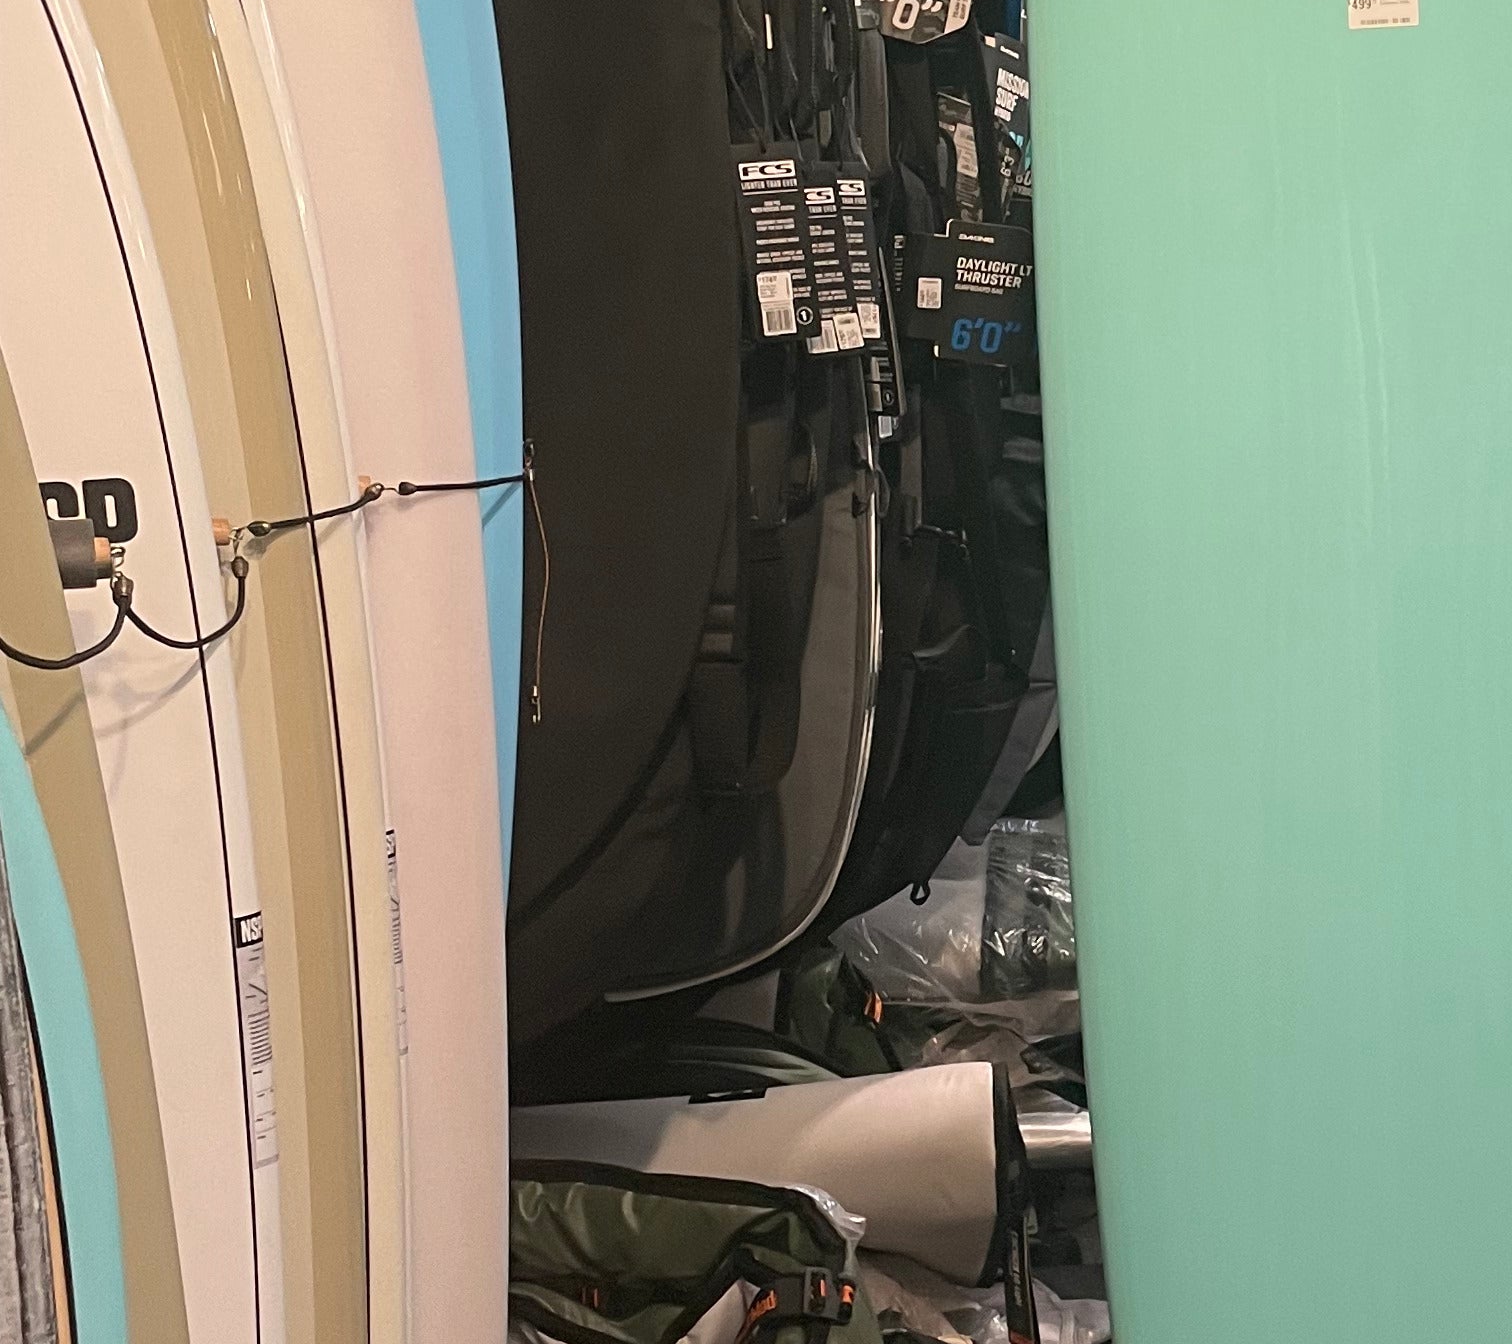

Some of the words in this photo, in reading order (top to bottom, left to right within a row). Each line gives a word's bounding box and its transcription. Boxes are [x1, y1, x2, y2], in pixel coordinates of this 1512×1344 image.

[742, 163, 793, 177] FCS
[957, 257, 1018, 275] DAYLIGHT
[1020, 265, 1032, 276] LT
[956, 270, 1021, 288] THRUSTER
